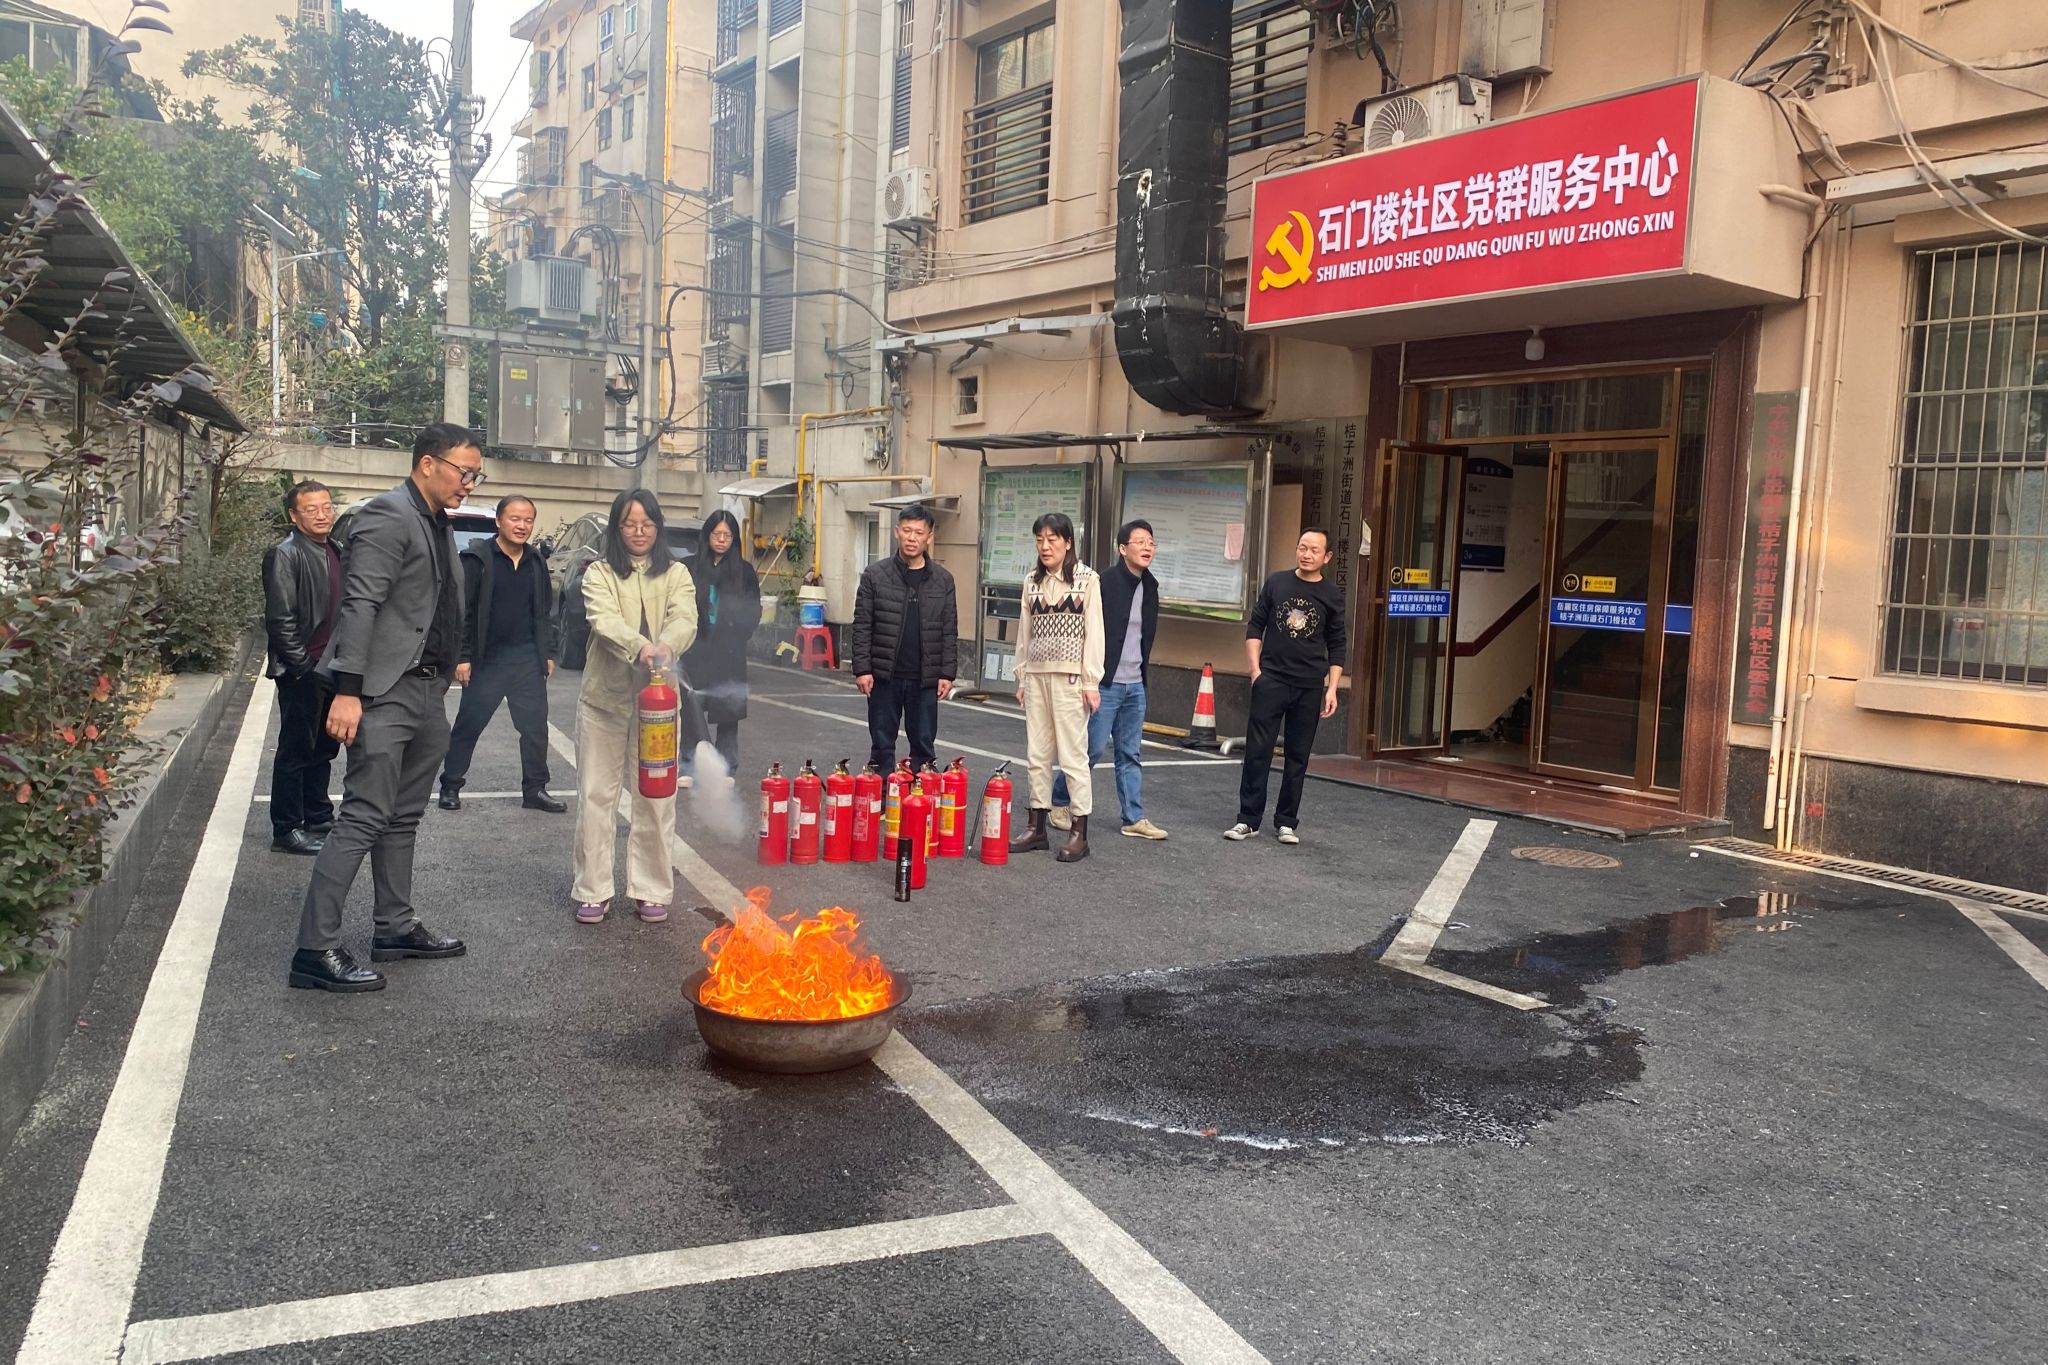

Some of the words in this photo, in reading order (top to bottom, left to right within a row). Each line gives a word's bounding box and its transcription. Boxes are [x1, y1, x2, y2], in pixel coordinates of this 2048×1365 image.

[1318, 136, 1680, 255] 石门楼社区党群服务中心
[1316, 266, 1337, 283] SHI
[1339, 260, 1366, 279] MEN
[1368, 254, 1393, 274] LOU
[1395, 250, 1421, 270] SHE
[1422, 247, 1444, 266] QU
[1445, 239, 1488, 262] DANG
[1490, 233, 1524, 256] QUN
[1525, 230, 1545, 249] FU
[1548, 226, 1576, 246] WU
[1577, 216, 1640, 243] ZHONG
[1642, 210, 1675, 233] XIN
